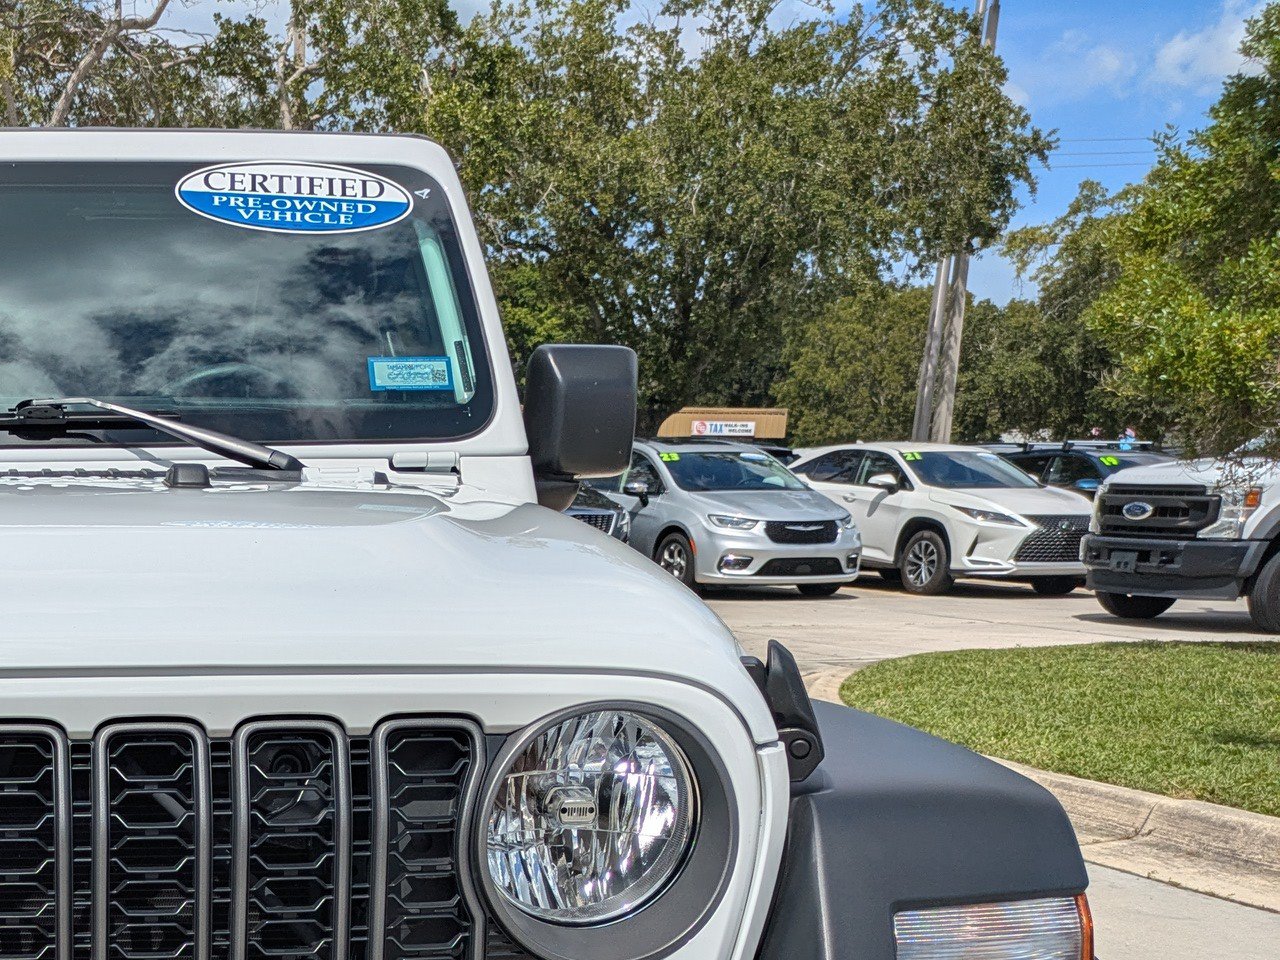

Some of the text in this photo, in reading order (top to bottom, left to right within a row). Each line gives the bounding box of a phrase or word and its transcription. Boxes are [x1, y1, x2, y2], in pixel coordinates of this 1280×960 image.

[203, 171, 385, 198] CERTIFIED
[212, 195, 377, 214] PRE-OWNED
[236, 208, 353, 225] VEHICLE
[709, 423, 723, 433] TAX
